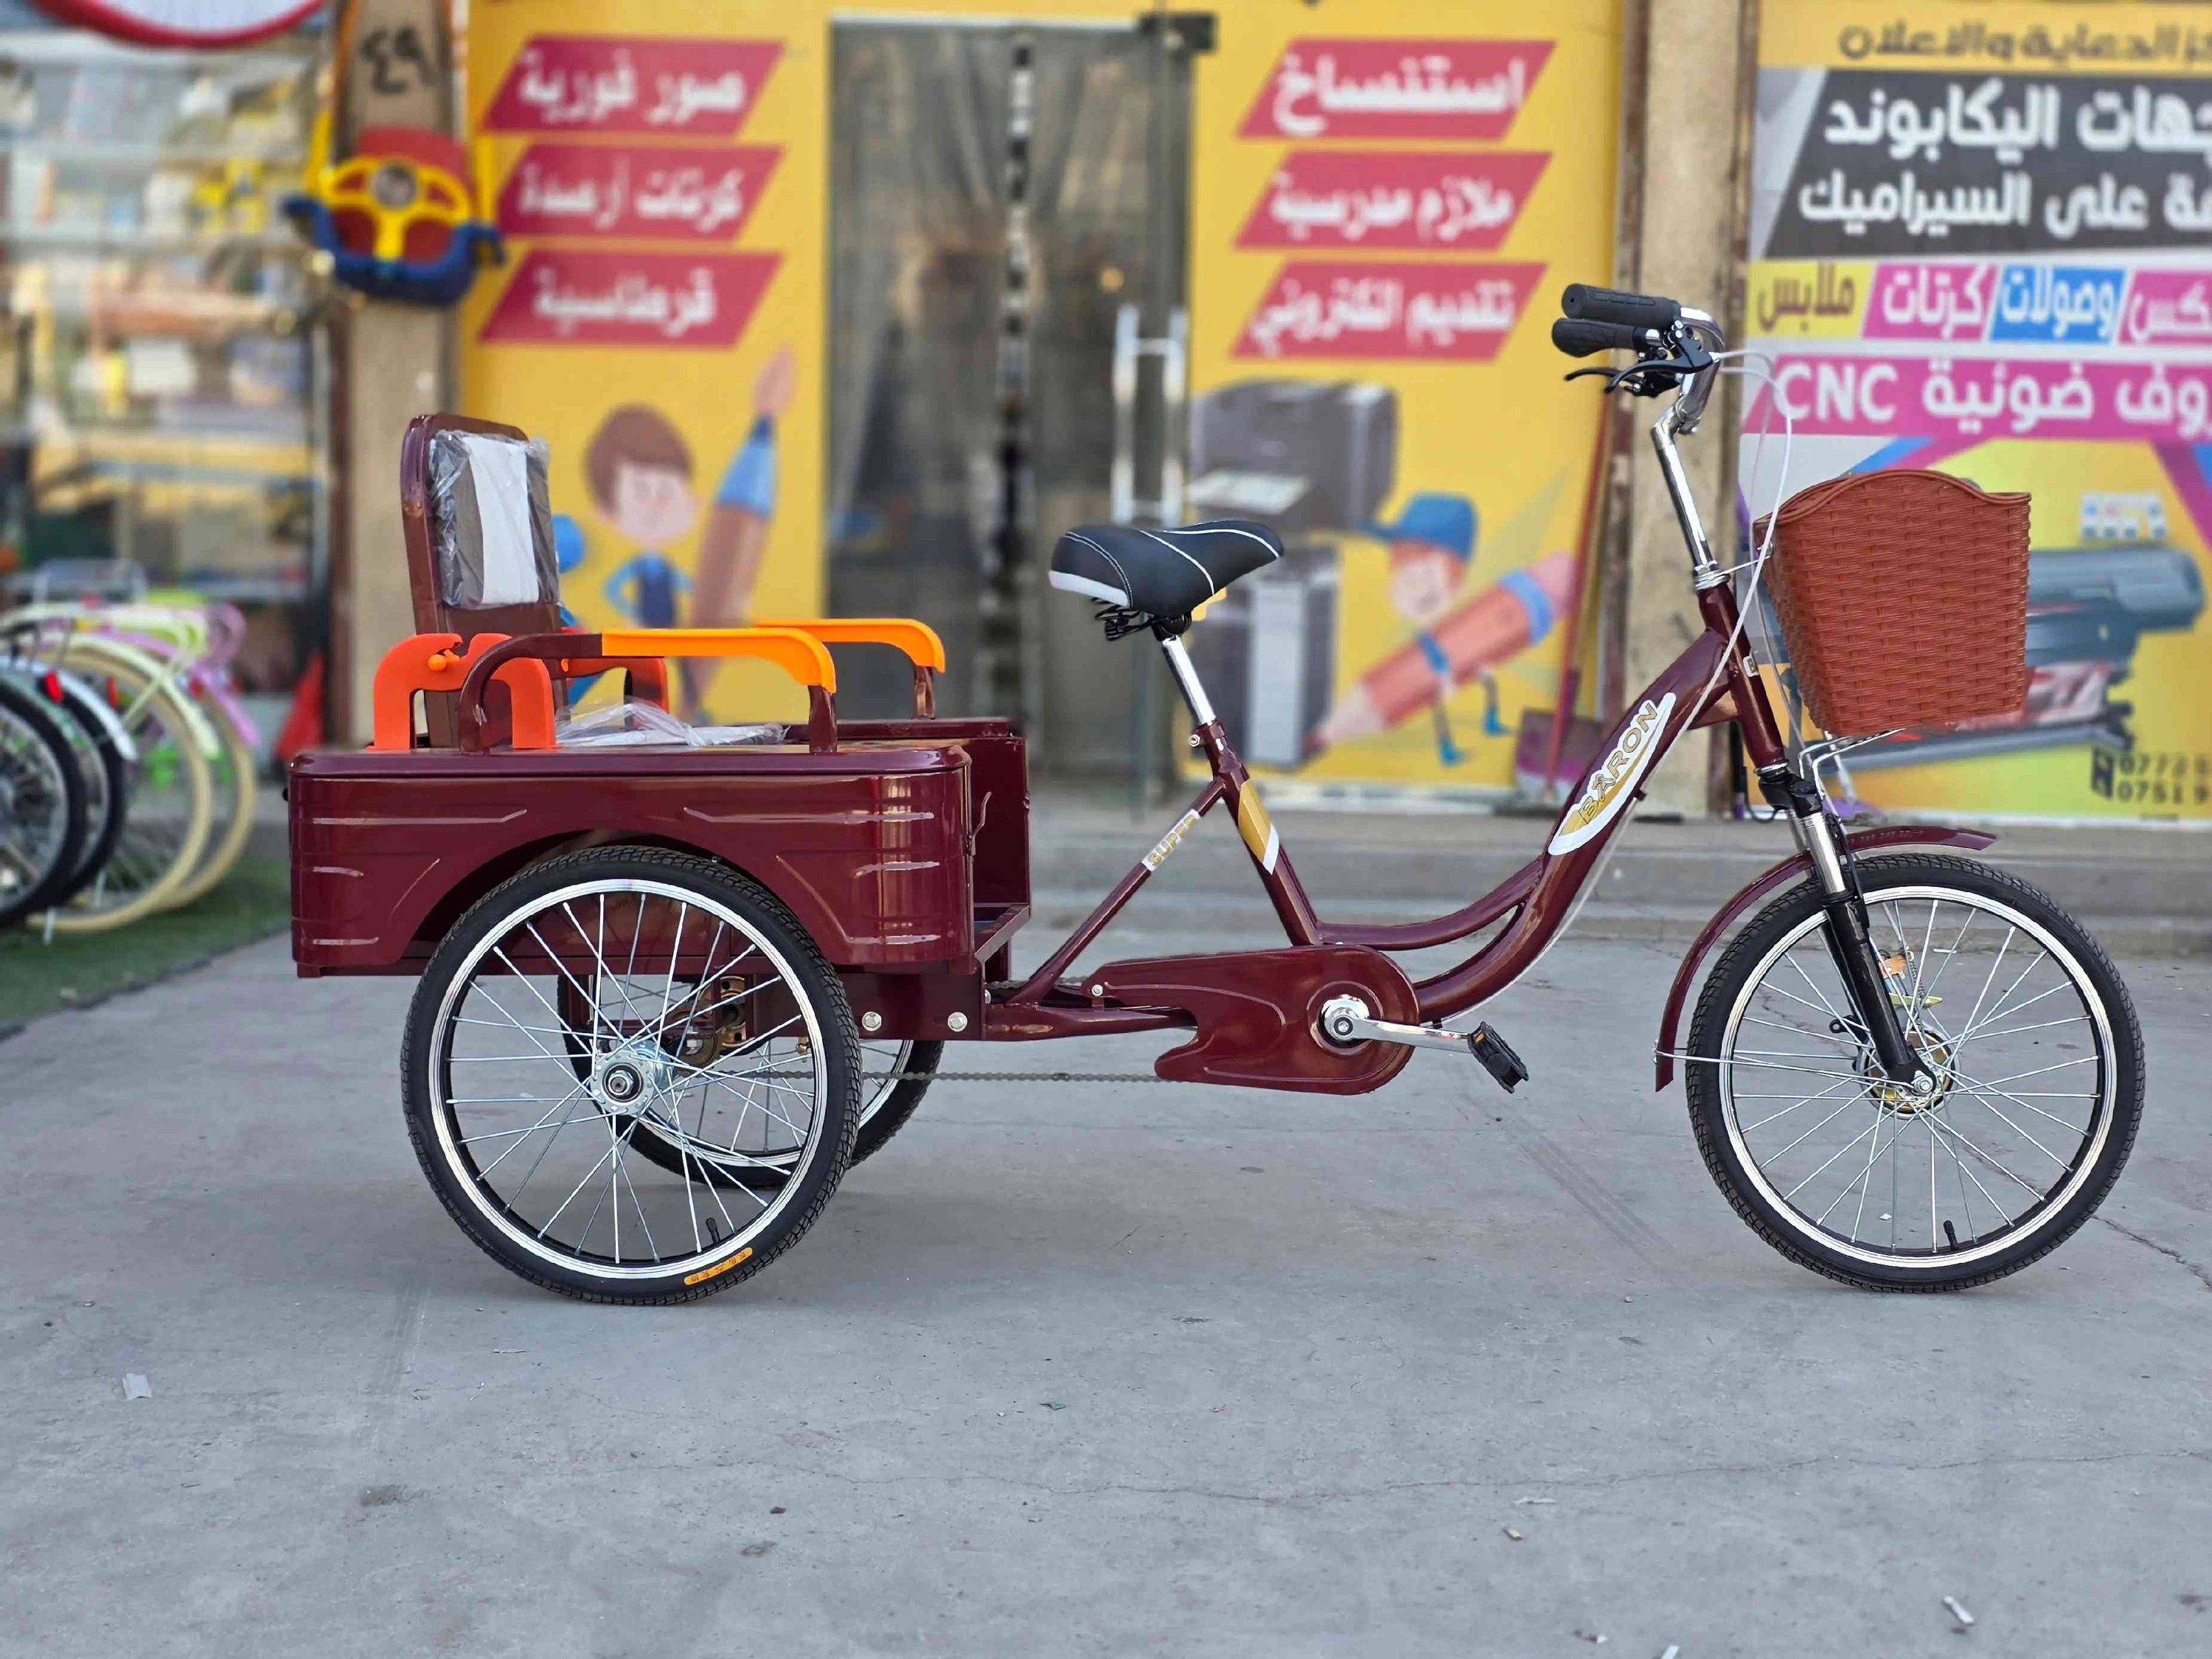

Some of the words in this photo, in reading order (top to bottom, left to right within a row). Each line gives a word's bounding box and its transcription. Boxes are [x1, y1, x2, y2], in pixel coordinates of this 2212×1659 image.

[518, 49, 638, 124] فورية
[644, 70, 745, 125] صور
[1271, 53, 1526, 136] استنساخ
[1824, 77, 2060, 164] اليكابوند
[1269, 170, 1413, 242] مدرسية
[1416, 174, 1514, 243] ملازم
[1799, 170, 2031, 236] السيراميك
[2045, 173, 2149, 238] على
[535, 267, 718, 337] قرطاسية
[1405, 279, 1515, 348] تقديم
[1756, 264, 1857, 332] ملابس
[1882, 264, 1990, 340] كرتات
[2001, 265, 2115, 338] وصولات
[1775, 362, 1899, 422] CNC
[1578, 702, 1658, 824] BARON
